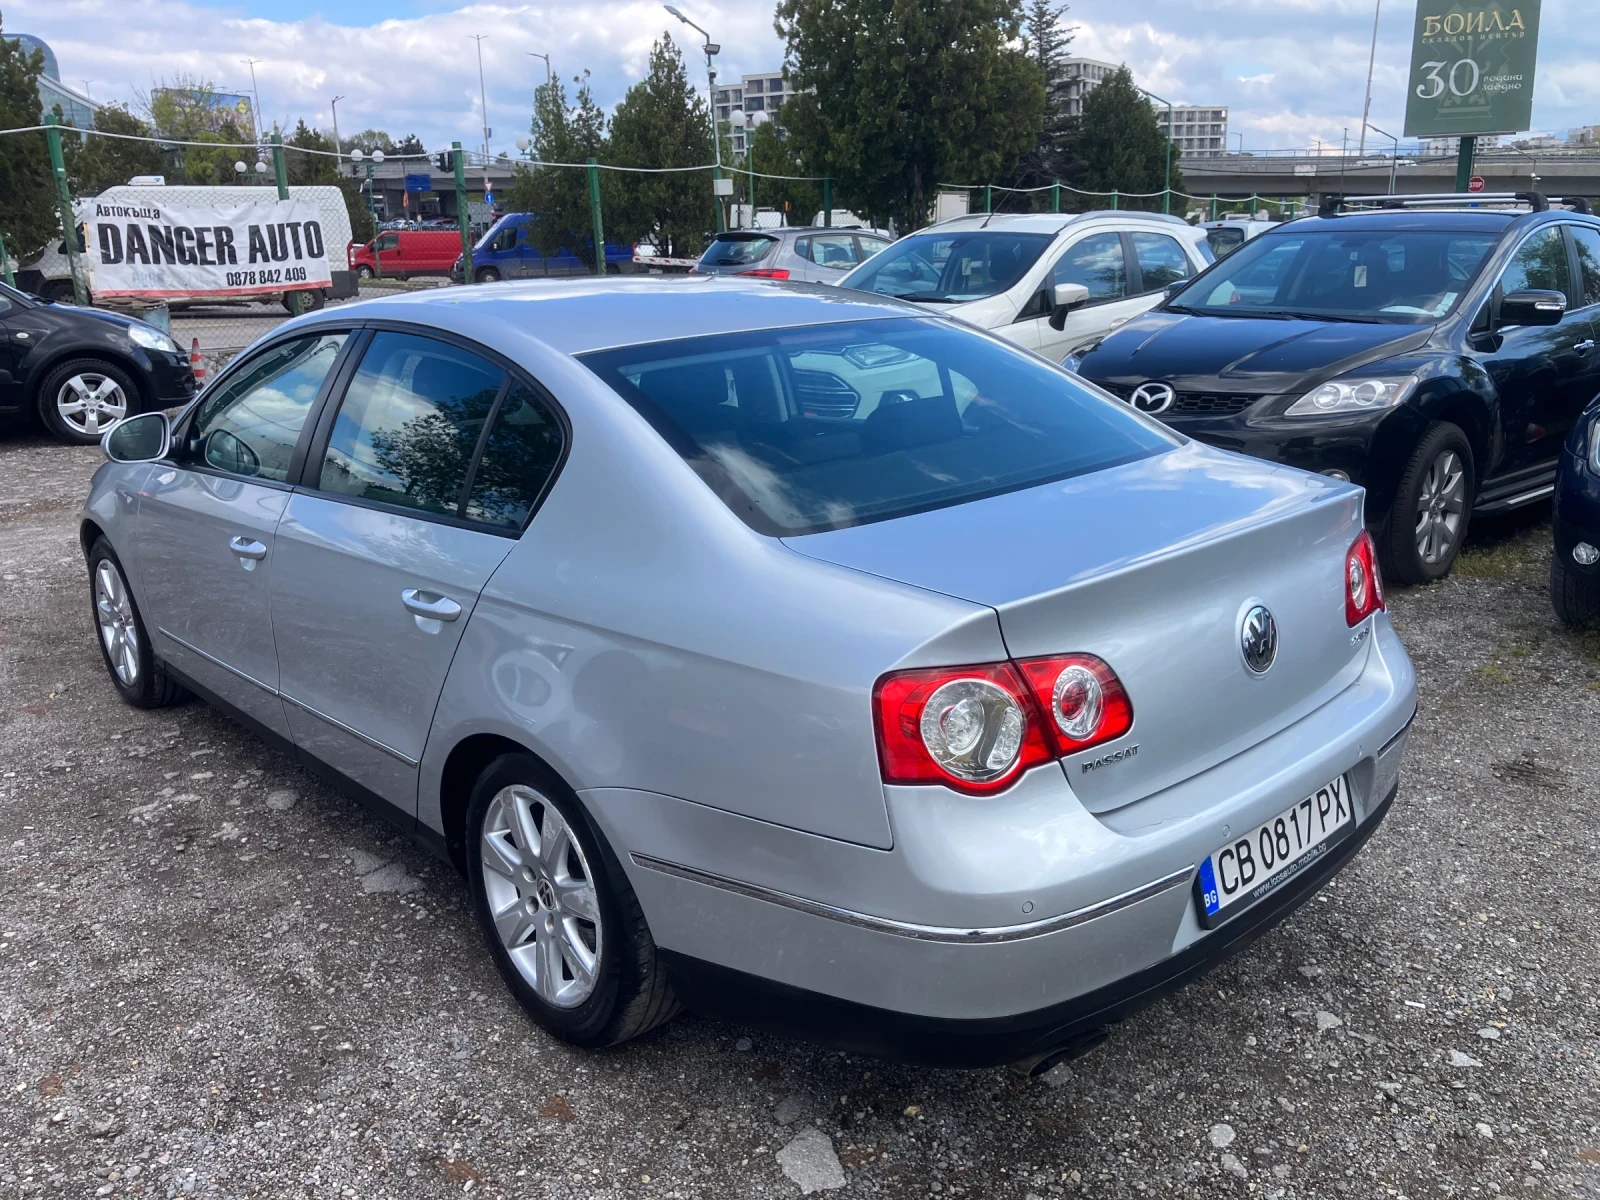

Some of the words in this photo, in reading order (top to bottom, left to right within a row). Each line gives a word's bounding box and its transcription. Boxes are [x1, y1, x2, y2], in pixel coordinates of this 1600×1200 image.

[1422, 9, 1526, 36] БОИЛА
[1416, 58, 1479, 98] 30
[97, 223, 238, 265] DANGER
[247, 220, 325, 264] AUTO
[226, 271, 258, 287] 0878
[259, 269, 282, 285] 842
[285, 267, 307, 282] 409
[1082, 744, 1140, 774] PASSAT
[1218, 839, 1256, 895] CB
[1259, 798, 1312, 870] 0817
[1316, 777, 1347, 833] PX
[1204, 890, 1217, 908] BG
